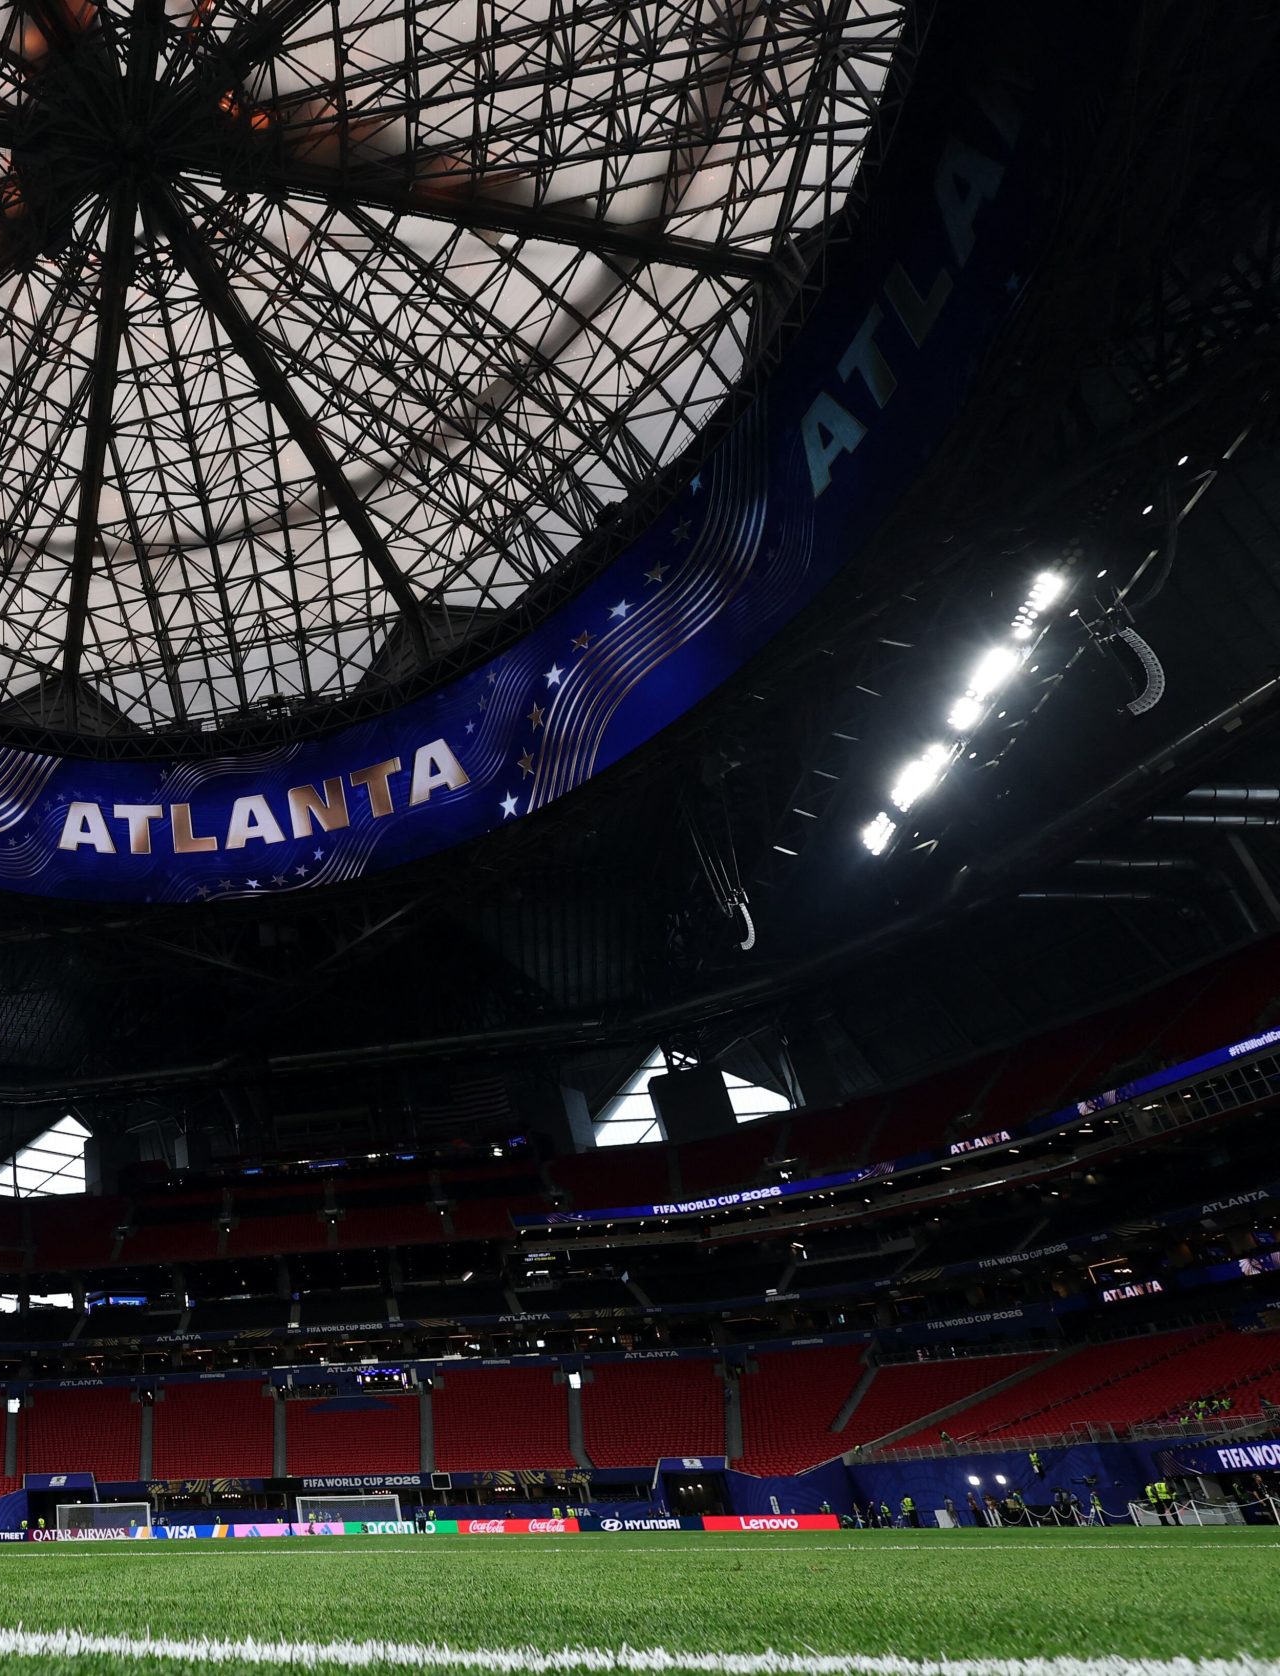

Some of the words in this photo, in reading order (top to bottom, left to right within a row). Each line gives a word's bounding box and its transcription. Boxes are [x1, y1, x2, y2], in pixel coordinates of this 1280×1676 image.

[57, 737, 471, 854] ATLANTA
[1228, 1030, 1280, 1057] #FIFAWorldCu
[950, 1130, 1012, 1155] ATLANTA
[652, 1205, 678, 1215] FIFA
[678, 1198, 717, 1212] WORLD
[718, 1194, 740, 1206] CUP
[741, 1186, 781, 1202] 2026
[1201, 1190, 1270, 1214] ATLANTA
[979, 1259, 998, 1269] FIFA
[999, 1253, 1029, 1265] WORLD
[1043, 1243, 1069, 1255] 2026
[1103, 1279, 1164, 1303] ATLANTA
[498, 1313, 551, 1323] ATLANTA
[927, 1321, 946, 1330] FIFA
[946, 1316, 975, 1327] WORLD
[975, 1313, 992, 1322] CUP
[993, 1309, 1023, 1320] 2026
[156, 1333, 202, 1343] ATLANTA
[624, 1350, 679, 1360] ATLANTA
[59, 1379, 104, 1388] ATLANTA
[1217, 1448, 1253, 1469] FIFA
[1246, 1444, 1280, 1466] WOR
[303, 1479, 325, 1488] FIFA
[325, 1478, 362, 1487] WORLD
[363, 1477, 384, 1486] CUP
[385, 1475, 421, 1485] 2026
[573, 1507, 591, 1516] IFA
[367, 1521, 436, 1534] aramo
[624, 1519, 681, 1530] HYUNDAI
[740, 1516, 798, 1530] Lenovo
[33, 1529, 72, 1541] QATAR
[77, 1527, 125, 1539] AIRWAYS
[165, 1525, 197, 1538] VISA
